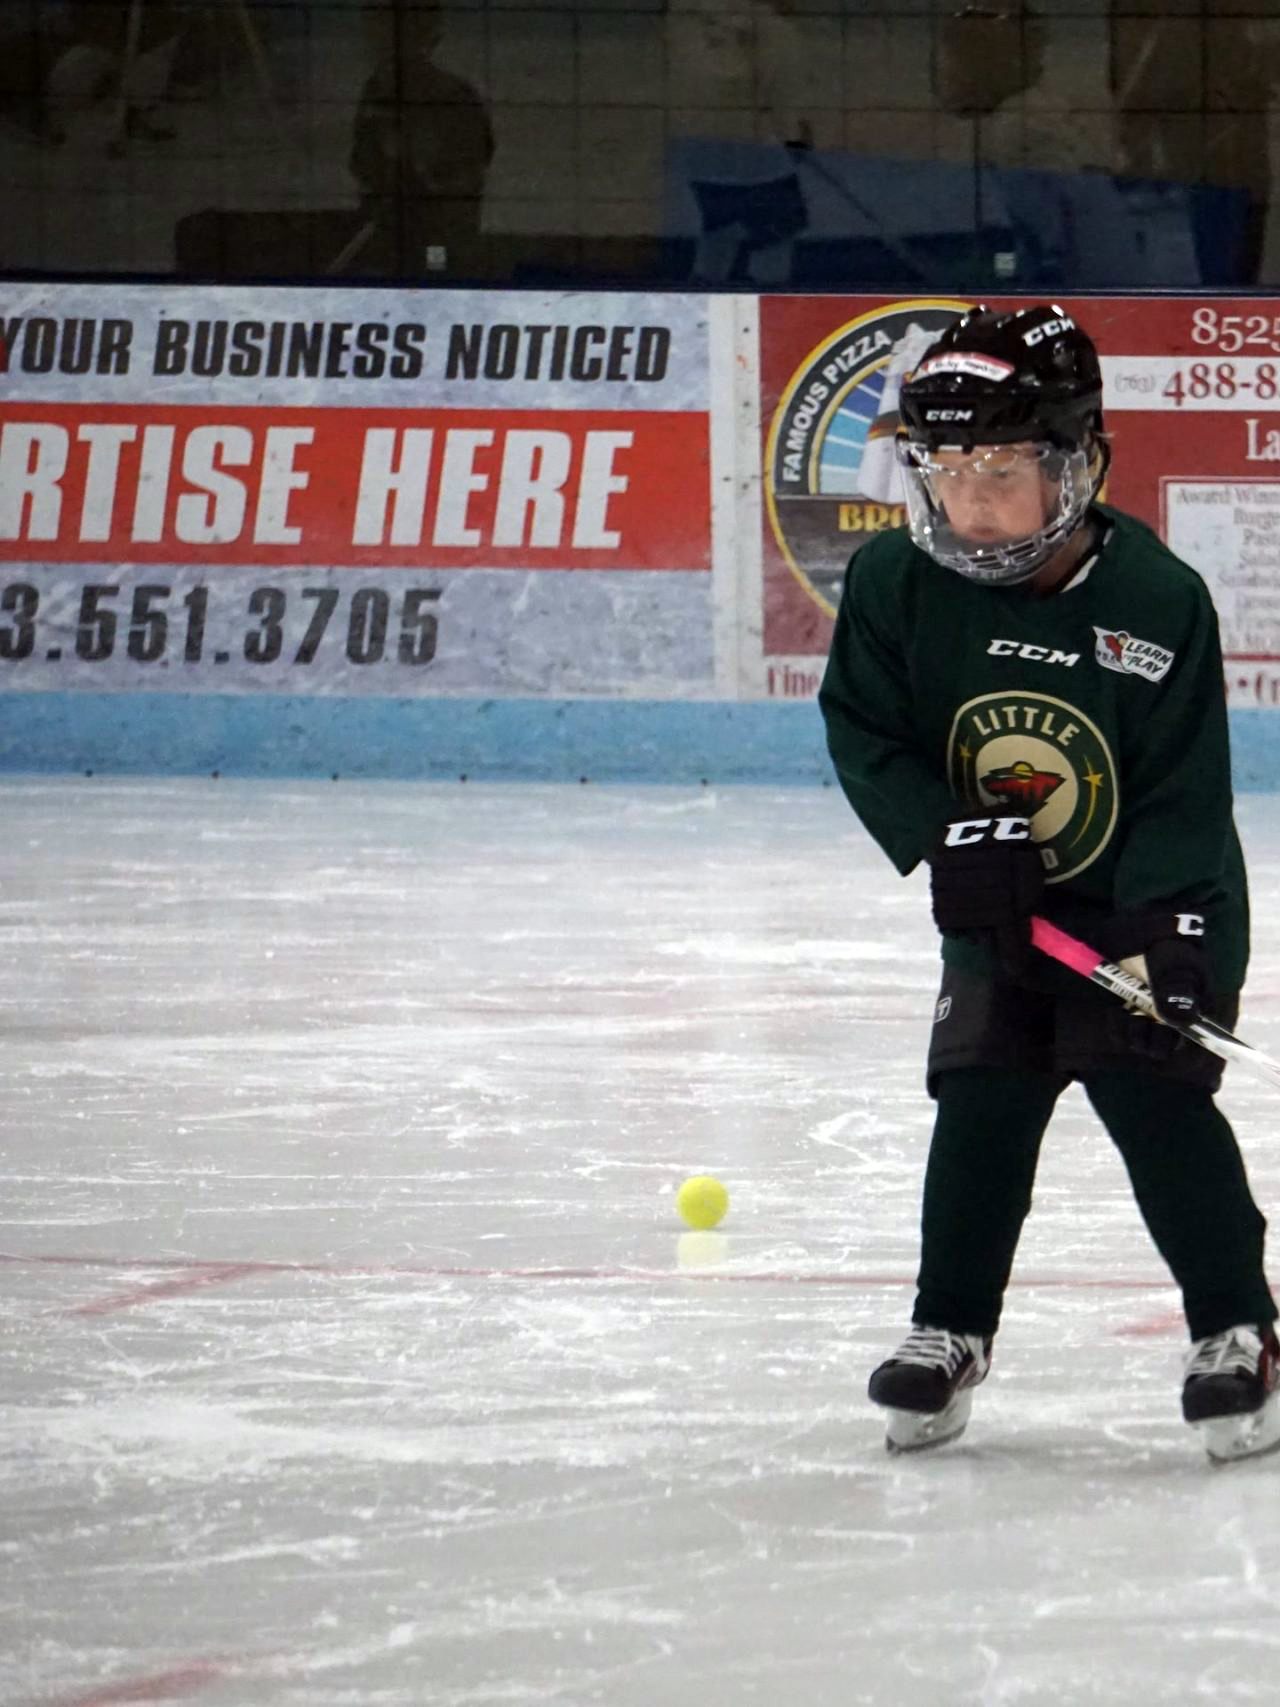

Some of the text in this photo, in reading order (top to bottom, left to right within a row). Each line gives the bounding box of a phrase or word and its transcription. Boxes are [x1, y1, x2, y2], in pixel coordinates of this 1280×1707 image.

[1022, 317, 1076, 347] CCM
[153, 319, 426, 379] BUSINESS
[445, 324, 672, 382] NOTICED
[782, 329, 892, 482] FAMOUS PIZZA
[925, 409, 974, 421] CCM
[351, 427, 635, 549] HERE
[1175, 487, 1231, 504] Award
[986, 639, 1081, 667] CCM
[1125, 641, 1173, 666] LEARN
[1127, 655, 1163, 675] PLAY
[972, 705, 1080, 747] LITTLE
